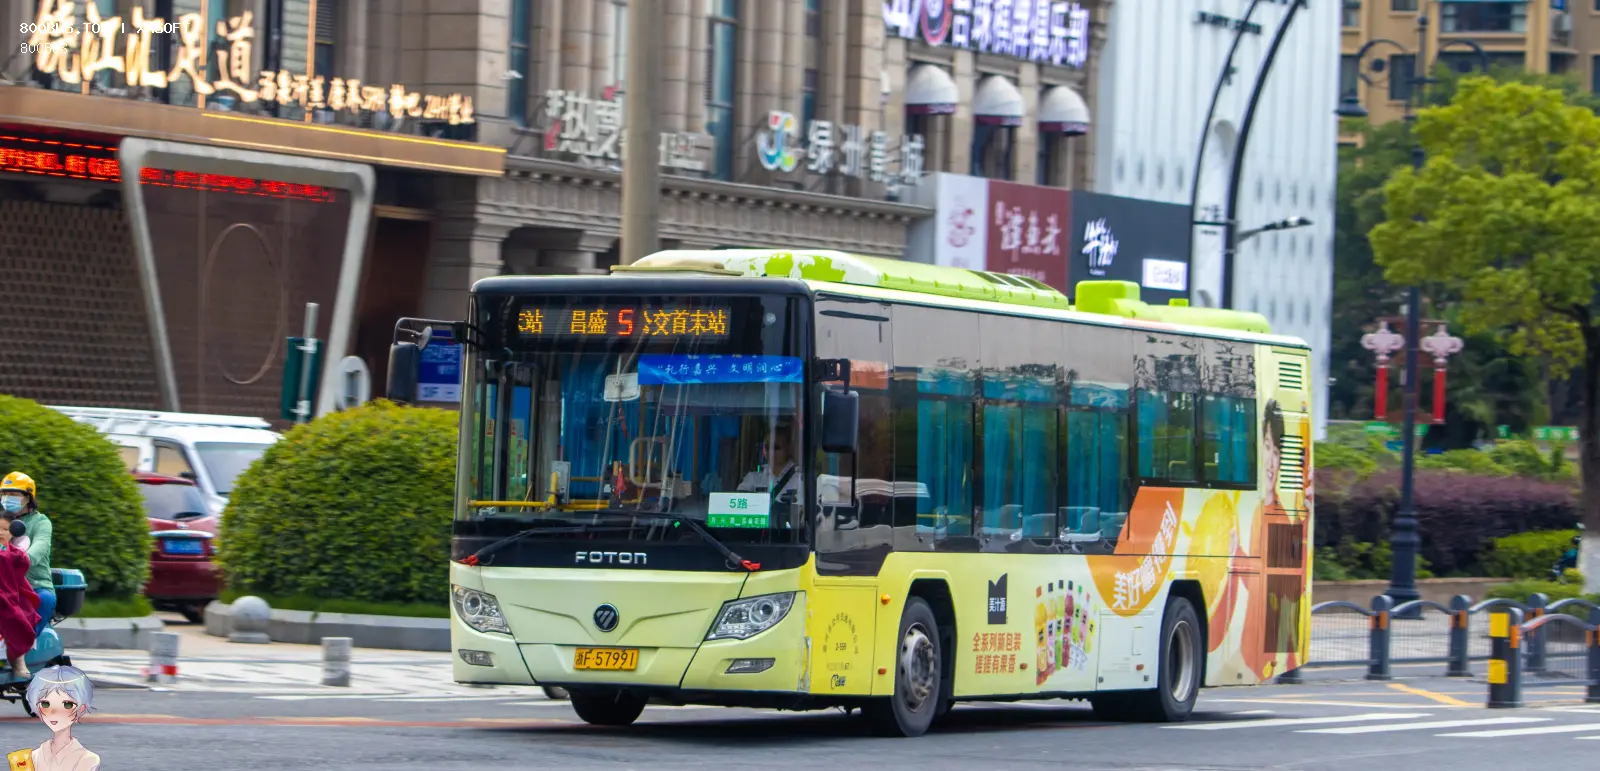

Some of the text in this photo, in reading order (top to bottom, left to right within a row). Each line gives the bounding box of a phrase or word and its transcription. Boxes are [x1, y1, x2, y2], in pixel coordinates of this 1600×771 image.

[570, 309, 608, 334] 昌盛
[616, 308, 633, 336] 5
[575, 551, 648, 565] FOTON
[988, 596, 1007, 612] 美汁源
[972, 632, 1022, 653] 全系列新包装
